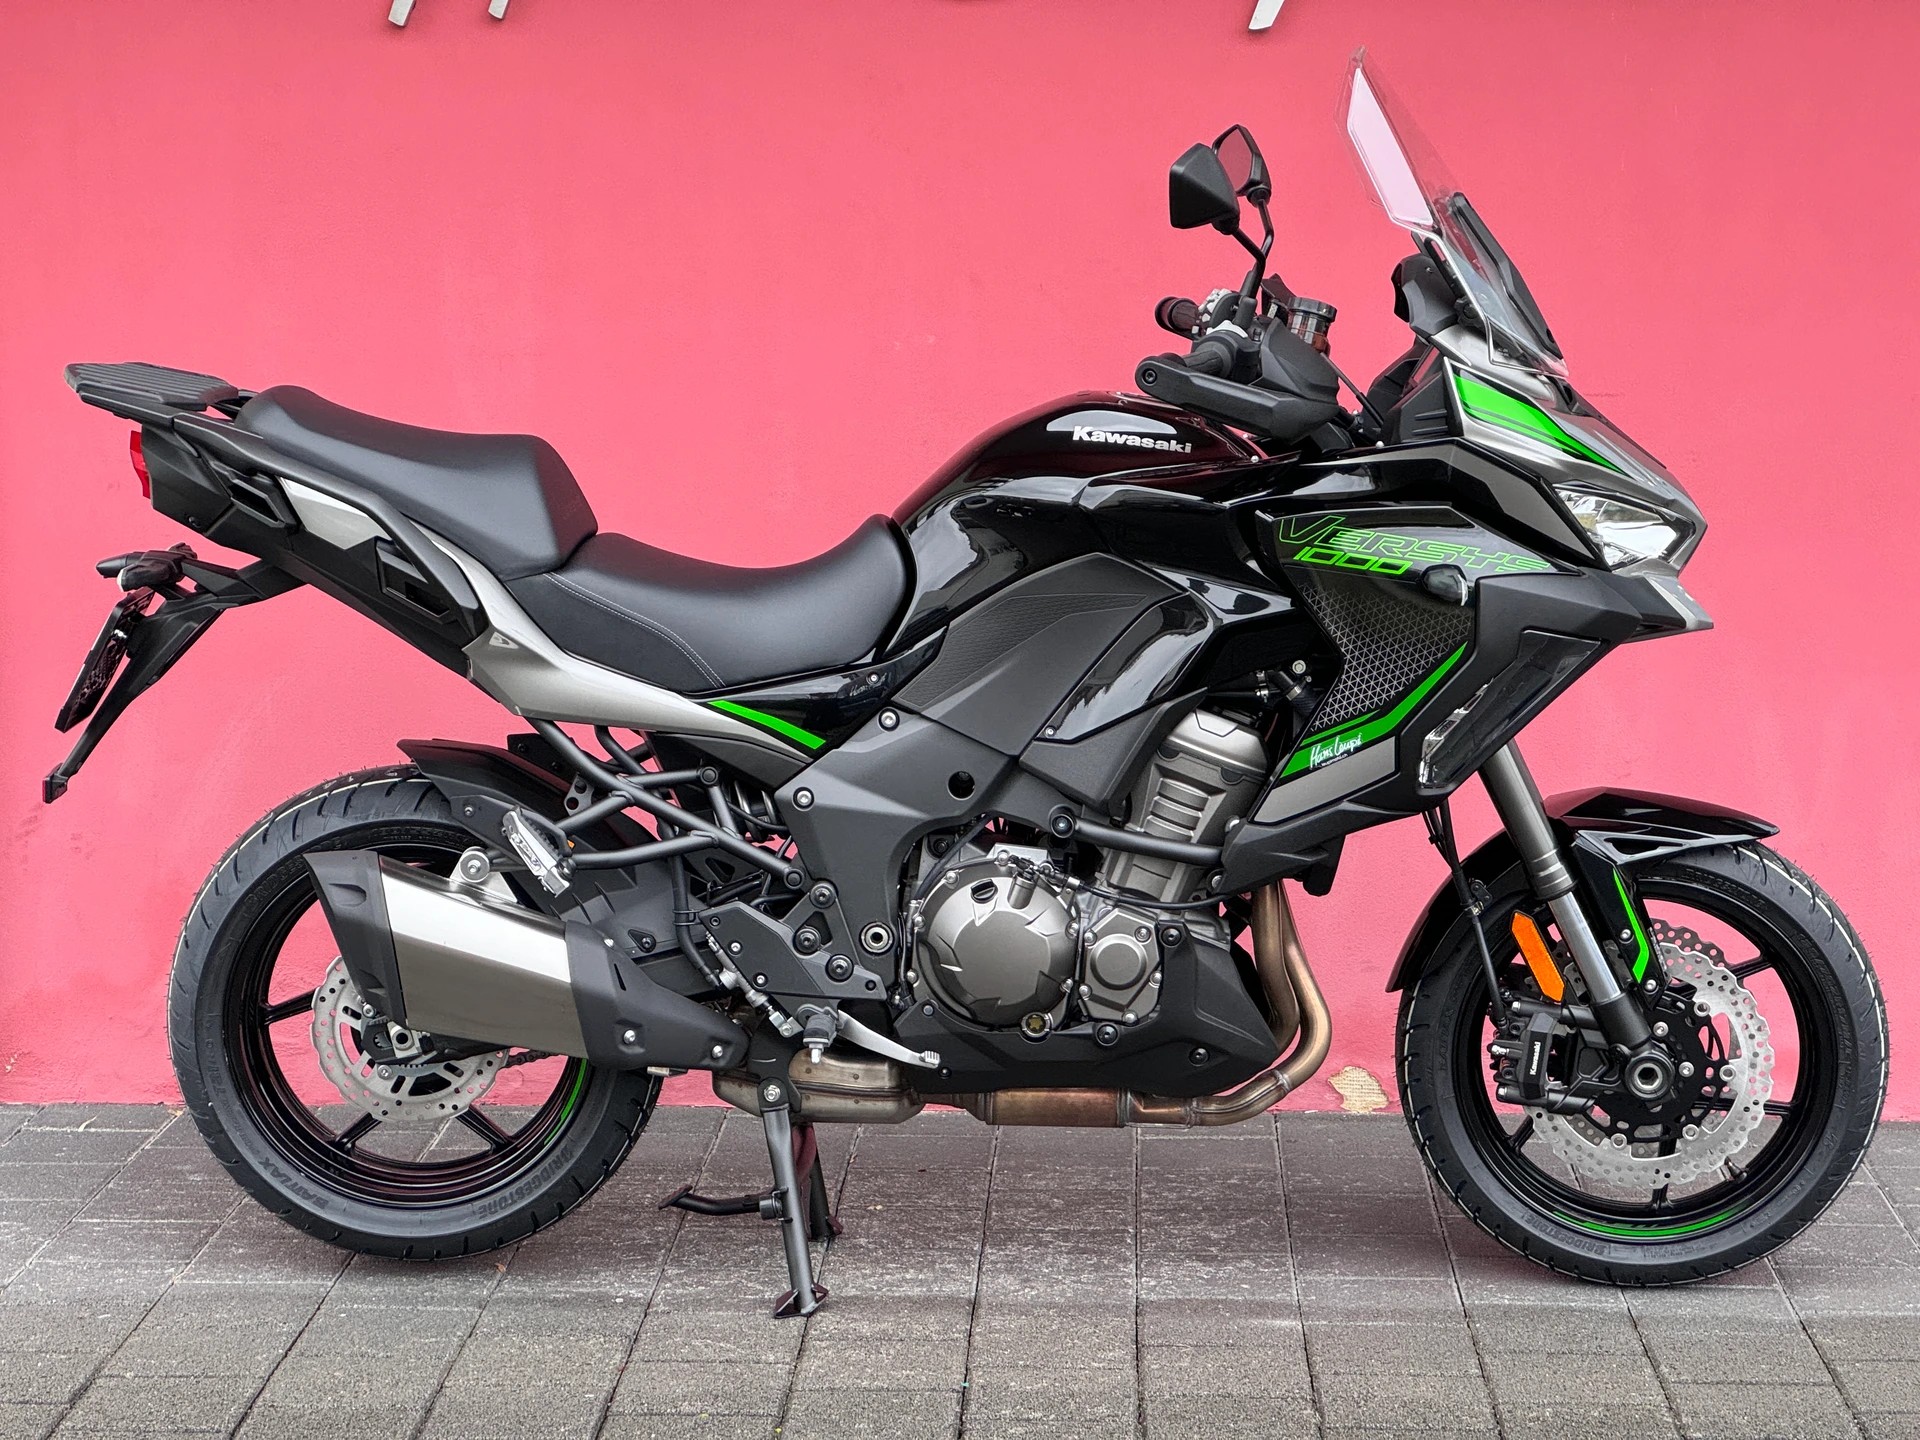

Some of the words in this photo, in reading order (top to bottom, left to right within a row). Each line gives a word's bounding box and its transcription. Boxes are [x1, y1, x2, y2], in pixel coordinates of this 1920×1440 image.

[1073, 425, 1192, 453] Kawasaki
[1279, 515, 1551, 572] VERSYS
[1293, 546, 1413, 574] 1000
[1310, 743, 1333, 769] Hans
